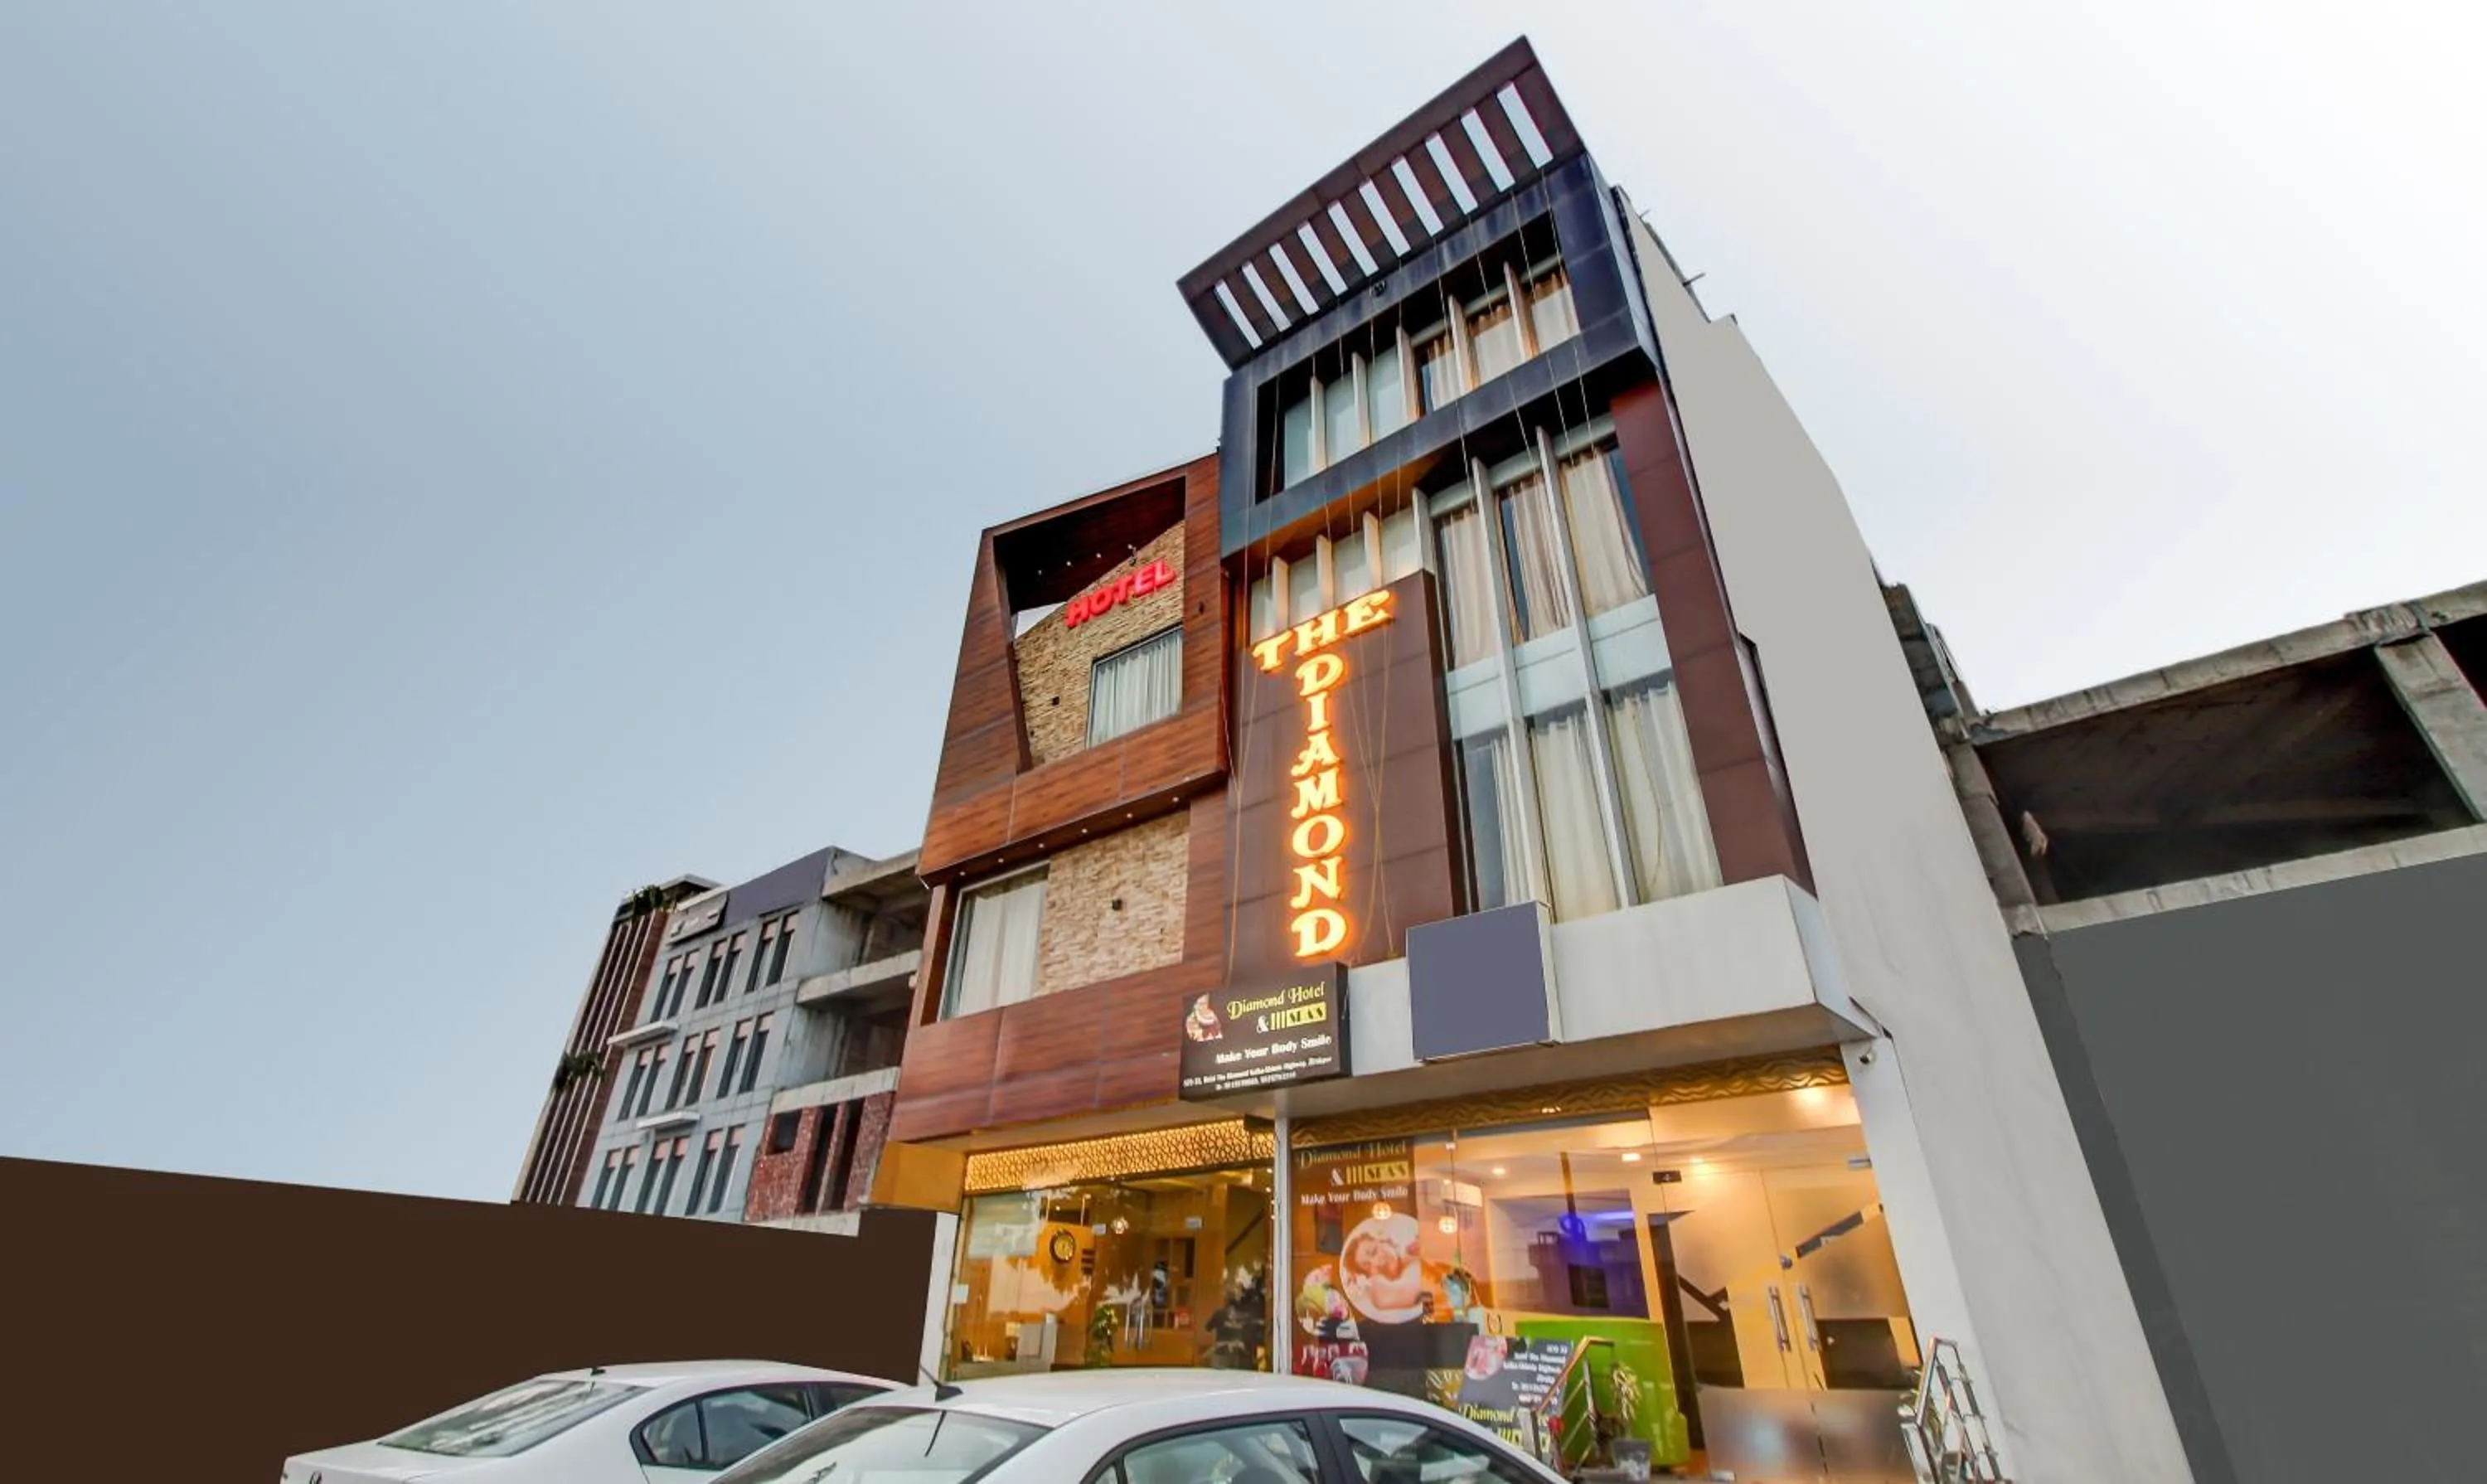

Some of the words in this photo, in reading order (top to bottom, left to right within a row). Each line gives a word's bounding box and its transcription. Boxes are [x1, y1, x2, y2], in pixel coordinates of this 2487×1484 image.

[1064, 557, 1176, 628] HOTEL
[1252, 589, 1394, 672] THE
[1290, 653, 1347, 958] DIAMOND
[1227, 989, 1286, 1020] Diamond
[1288, 982, 1325, 1003] Hotel
[1215, 1051, 1242, 1065] Make
[1244, 1047, 1268, 1060] Your
[1272, 1040, 1297, 1054] Body
[1301, 1034, 1331, 1049] Smile
[1300, 1144, 1360, 1170] Diamond
[1365, 1140, 1406, 1159] Hotel
[1301, 1194, 1326, 1205] Make
[1328, 1191, 1350, 1203] Your
[1353, 1187, 1377, 1202] Body
[1379, 1186, 1408, 1199] Smile
